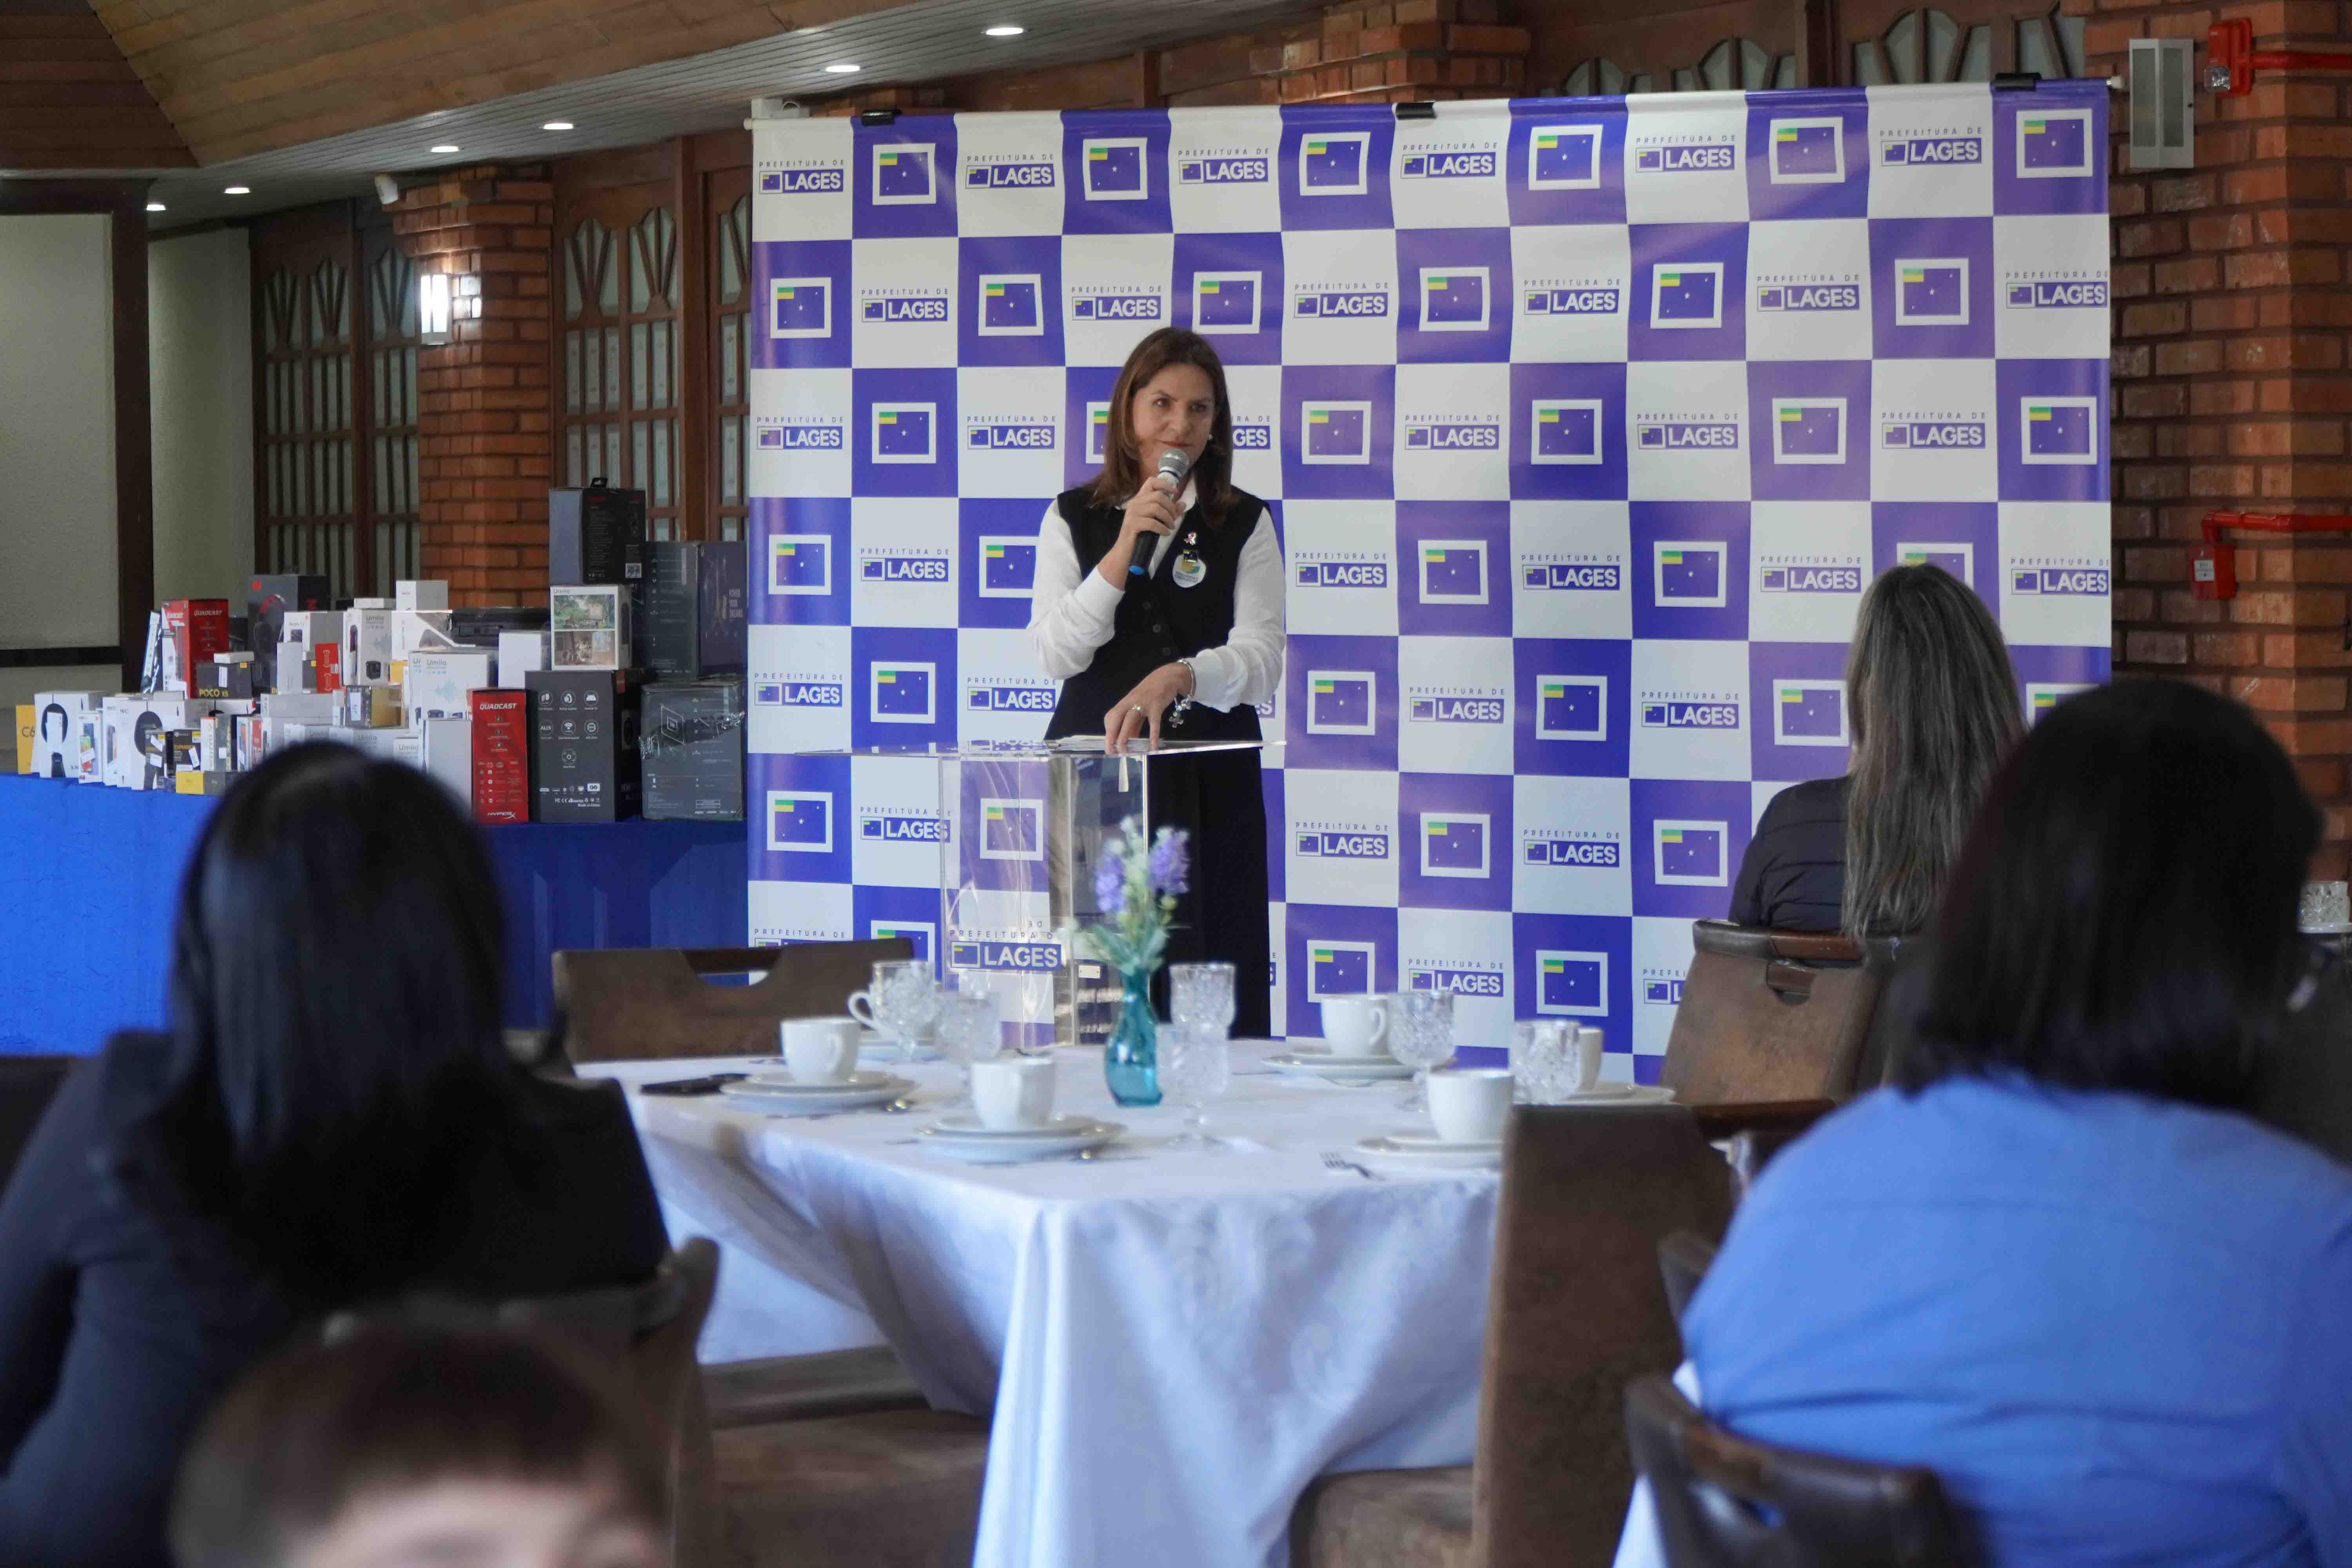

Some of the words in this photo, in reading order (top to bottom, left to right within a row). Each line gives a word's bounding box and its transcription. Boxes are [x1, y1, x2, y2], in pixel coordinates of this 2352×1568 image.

[1637, 134, 1712, 143] PREFEITURA
[1880, 128, 1957, 136] PREFEITURA
[1967, 126, 1982, 134] DE
[967, 154, 1034, 163] PREFEITURA
[1665, 148, 1732, 169] LAGES
[1910, 141, 1979, 162] LAGES
[1205, 161, 1266, 180] LAGES
[1429, 154, 1493, 175] LAGES
[784, 172, 841, 191] LAGES
[993, 166, 1053, 185] LAGES
[1757, 274, 1834, 283] PREFEITURA
[1552, 292, 1616, 311] LAGES
[1787, 288, 1857, 308] LAGES
[2037, 284, 2106, 305] LAGES
[887, 300, 946, 319] LAGES
[1098, 298, 1159, 318] LAGES
[1322, 295, 1385, 315] LAGES
[786, 429, 840, 447] LAGES
[993, 428, 1052, 446] LAGES
[1232, 428, 1268, 447] GES
[1433, 428, 1496, 447] LAGES
[1668, 426, 1735, 446] LAGES
[1912, 425, 1983, 446] LAGES
[887, 561, 946, 579] LAGES
[1323, 566, 1385, 585] LAGES
[1552, 568, 1617, 587] LAGES
[1790, 570, 1858, 590] LAGES
[2043, 572, 2107, 592] LAGES
[784, 685, 840, 704] LAGES
[994, 690, 1054, 710] LAGES
[1409, 687, 1482, 695] PREFEITURA
[1641, 691, 1715, 700] PREFEITURA
[1438, 701, 1501, 720] LAGES
[1670, 706, 1737, 726] LAGES
[860, 806, 927, 815] PREFEITURA
[886, 820, 949, 840] LAGES
[1296, 822, 1367, 830] PREFEITURA
[1524, 829, 1597, 838] PREFEITURA
[1323, 835, 1386, 856] LAGES
[1552, 844, 1617, 864] LAGES
[754, 928, 825, 938] PREFEITURA
[950, 929, 1035, 939] PREFEITURA
[984, 946, 1058, 967] LAGES
[1408, 958, 1481, 968] PREFEITURA
[1437, 972, 1501, 994] LAGES
